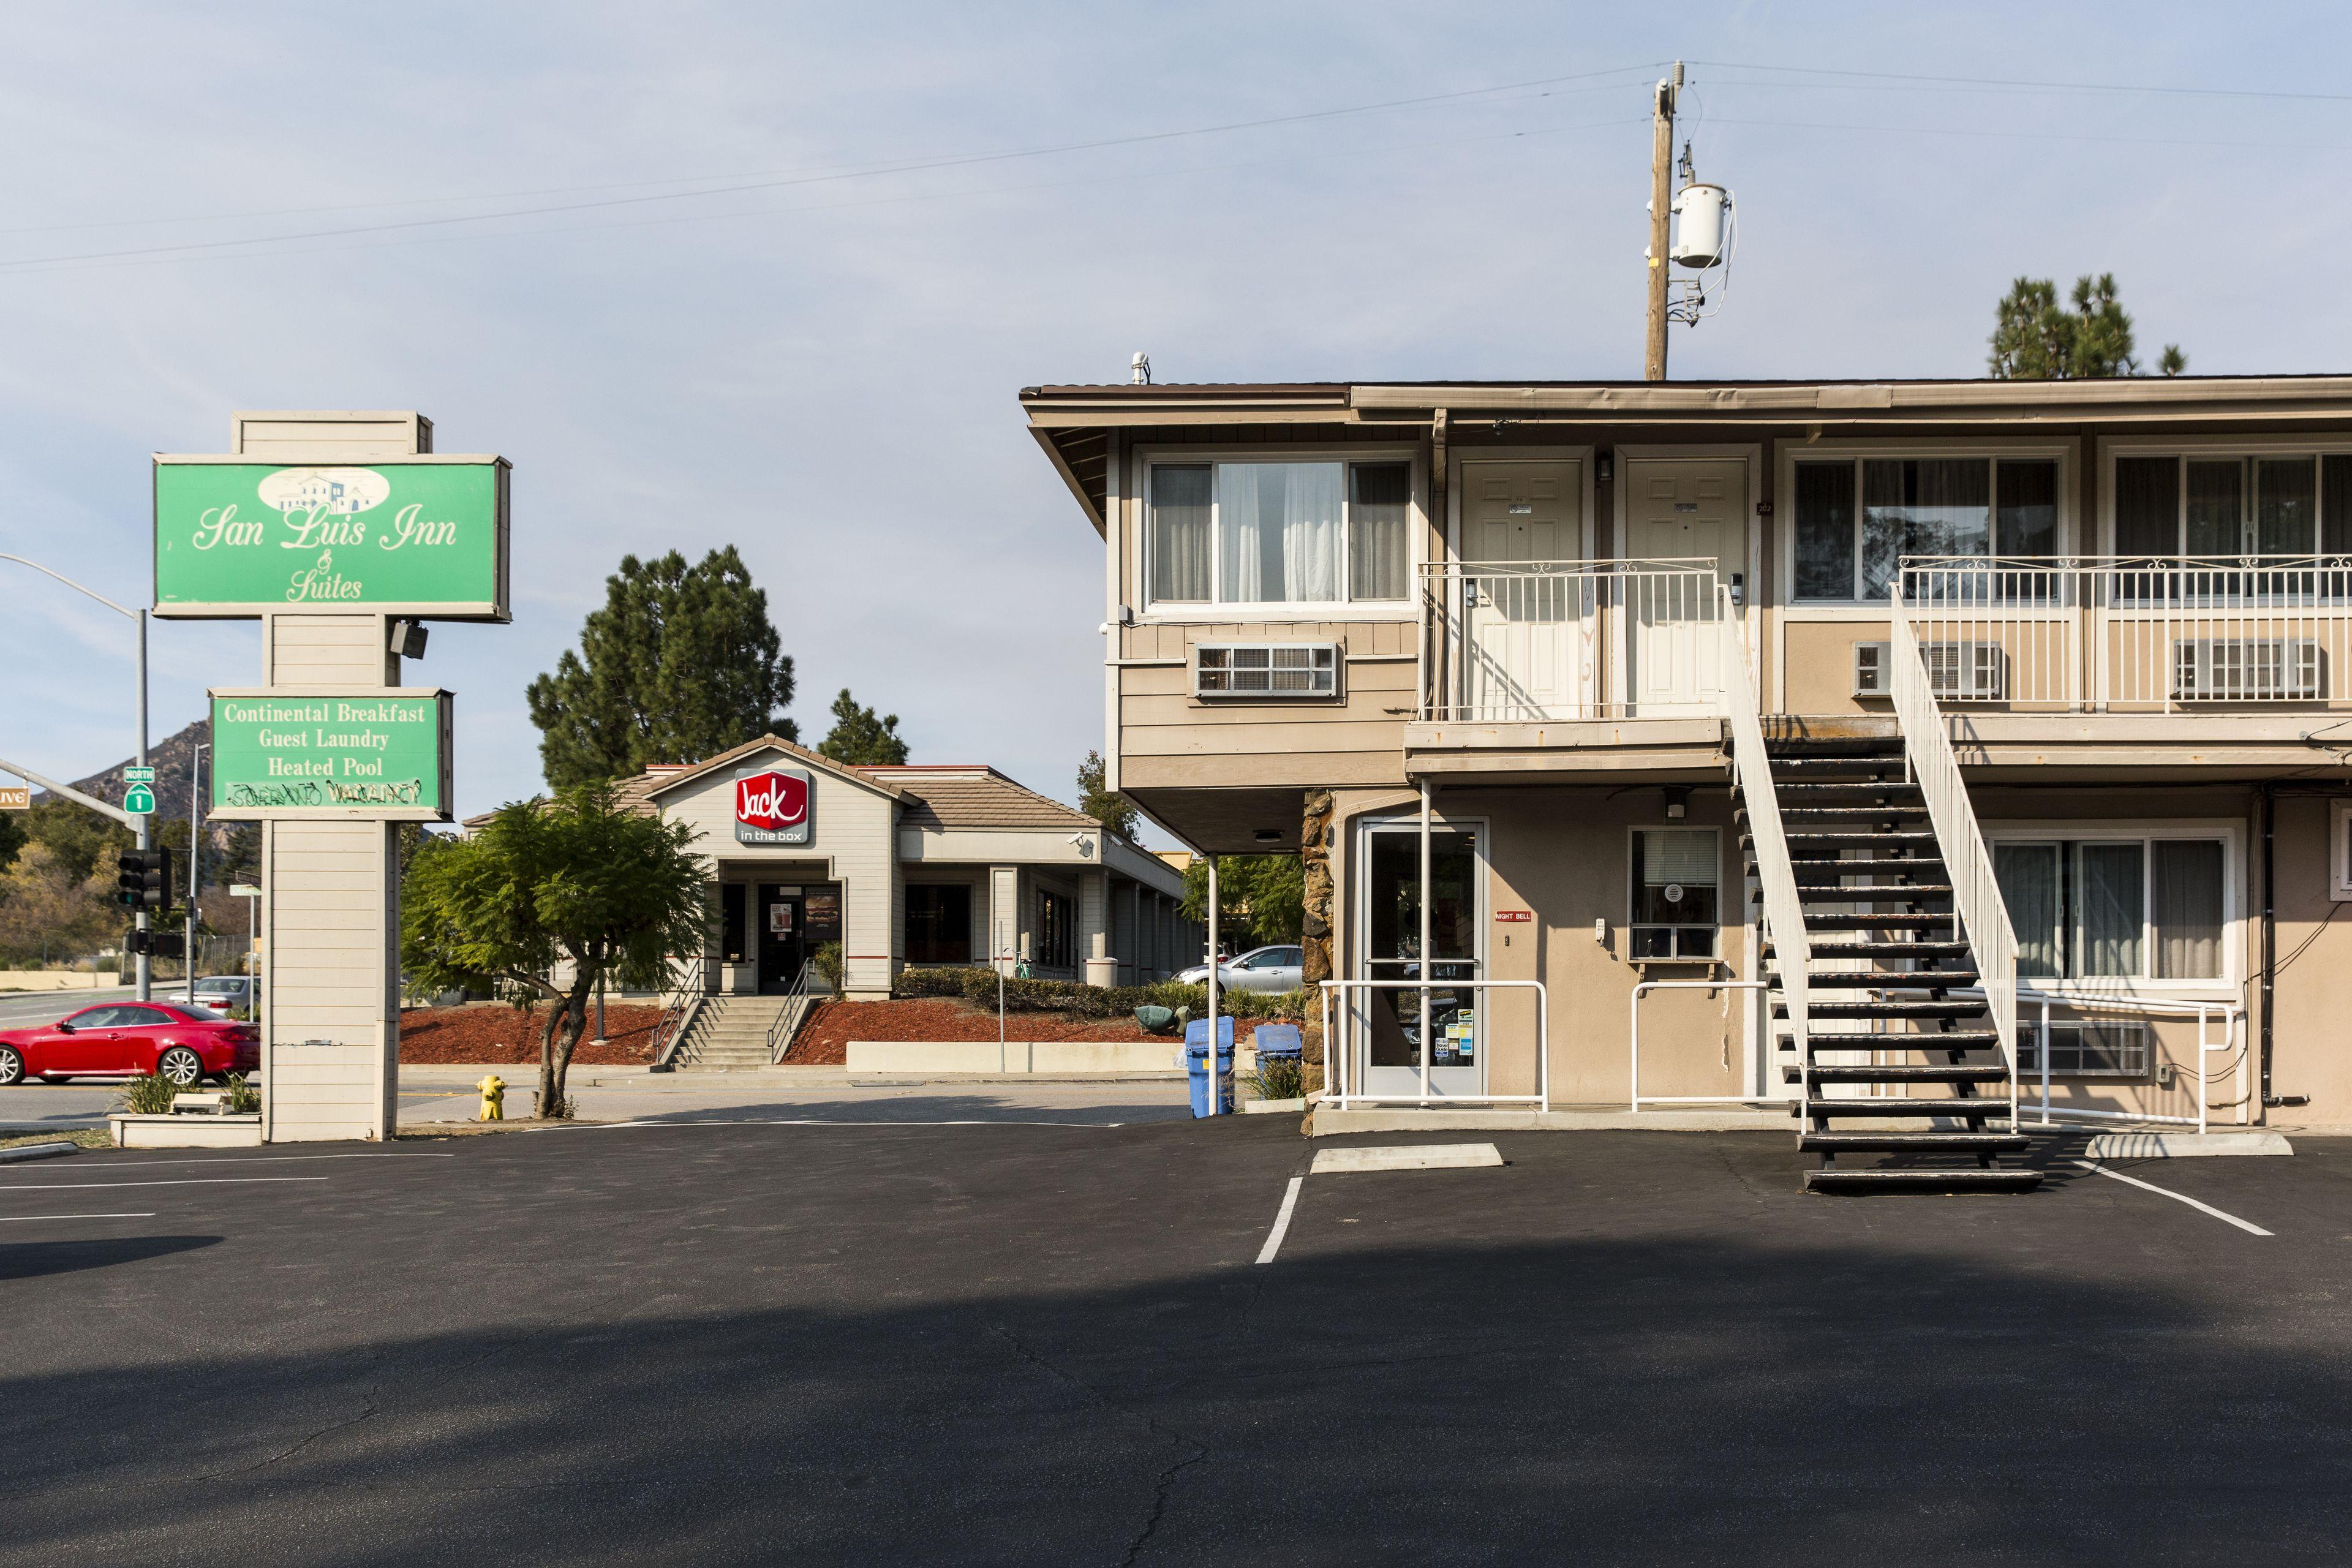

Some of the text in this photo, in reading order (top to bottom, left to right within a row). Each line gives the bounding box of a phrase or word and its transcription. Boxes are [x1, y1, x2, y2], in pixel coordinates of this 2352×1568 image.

[192, 502, 457, 551] San Luis Inn
[317, 548, 333, 576] &
[286, 568, 363, 603] Suites
[224, 703, 425, 723] Continental Breakfast
[258, 728, 390, 751] Guest Laundry
[126, 769, 153, 780] NORTH
[268, 757, 383, 776] Heated Pool
[136, 795, 142, 810] 1
[738, 778, 804, 821] Jack
[741, 831, 801, 840] in the box
